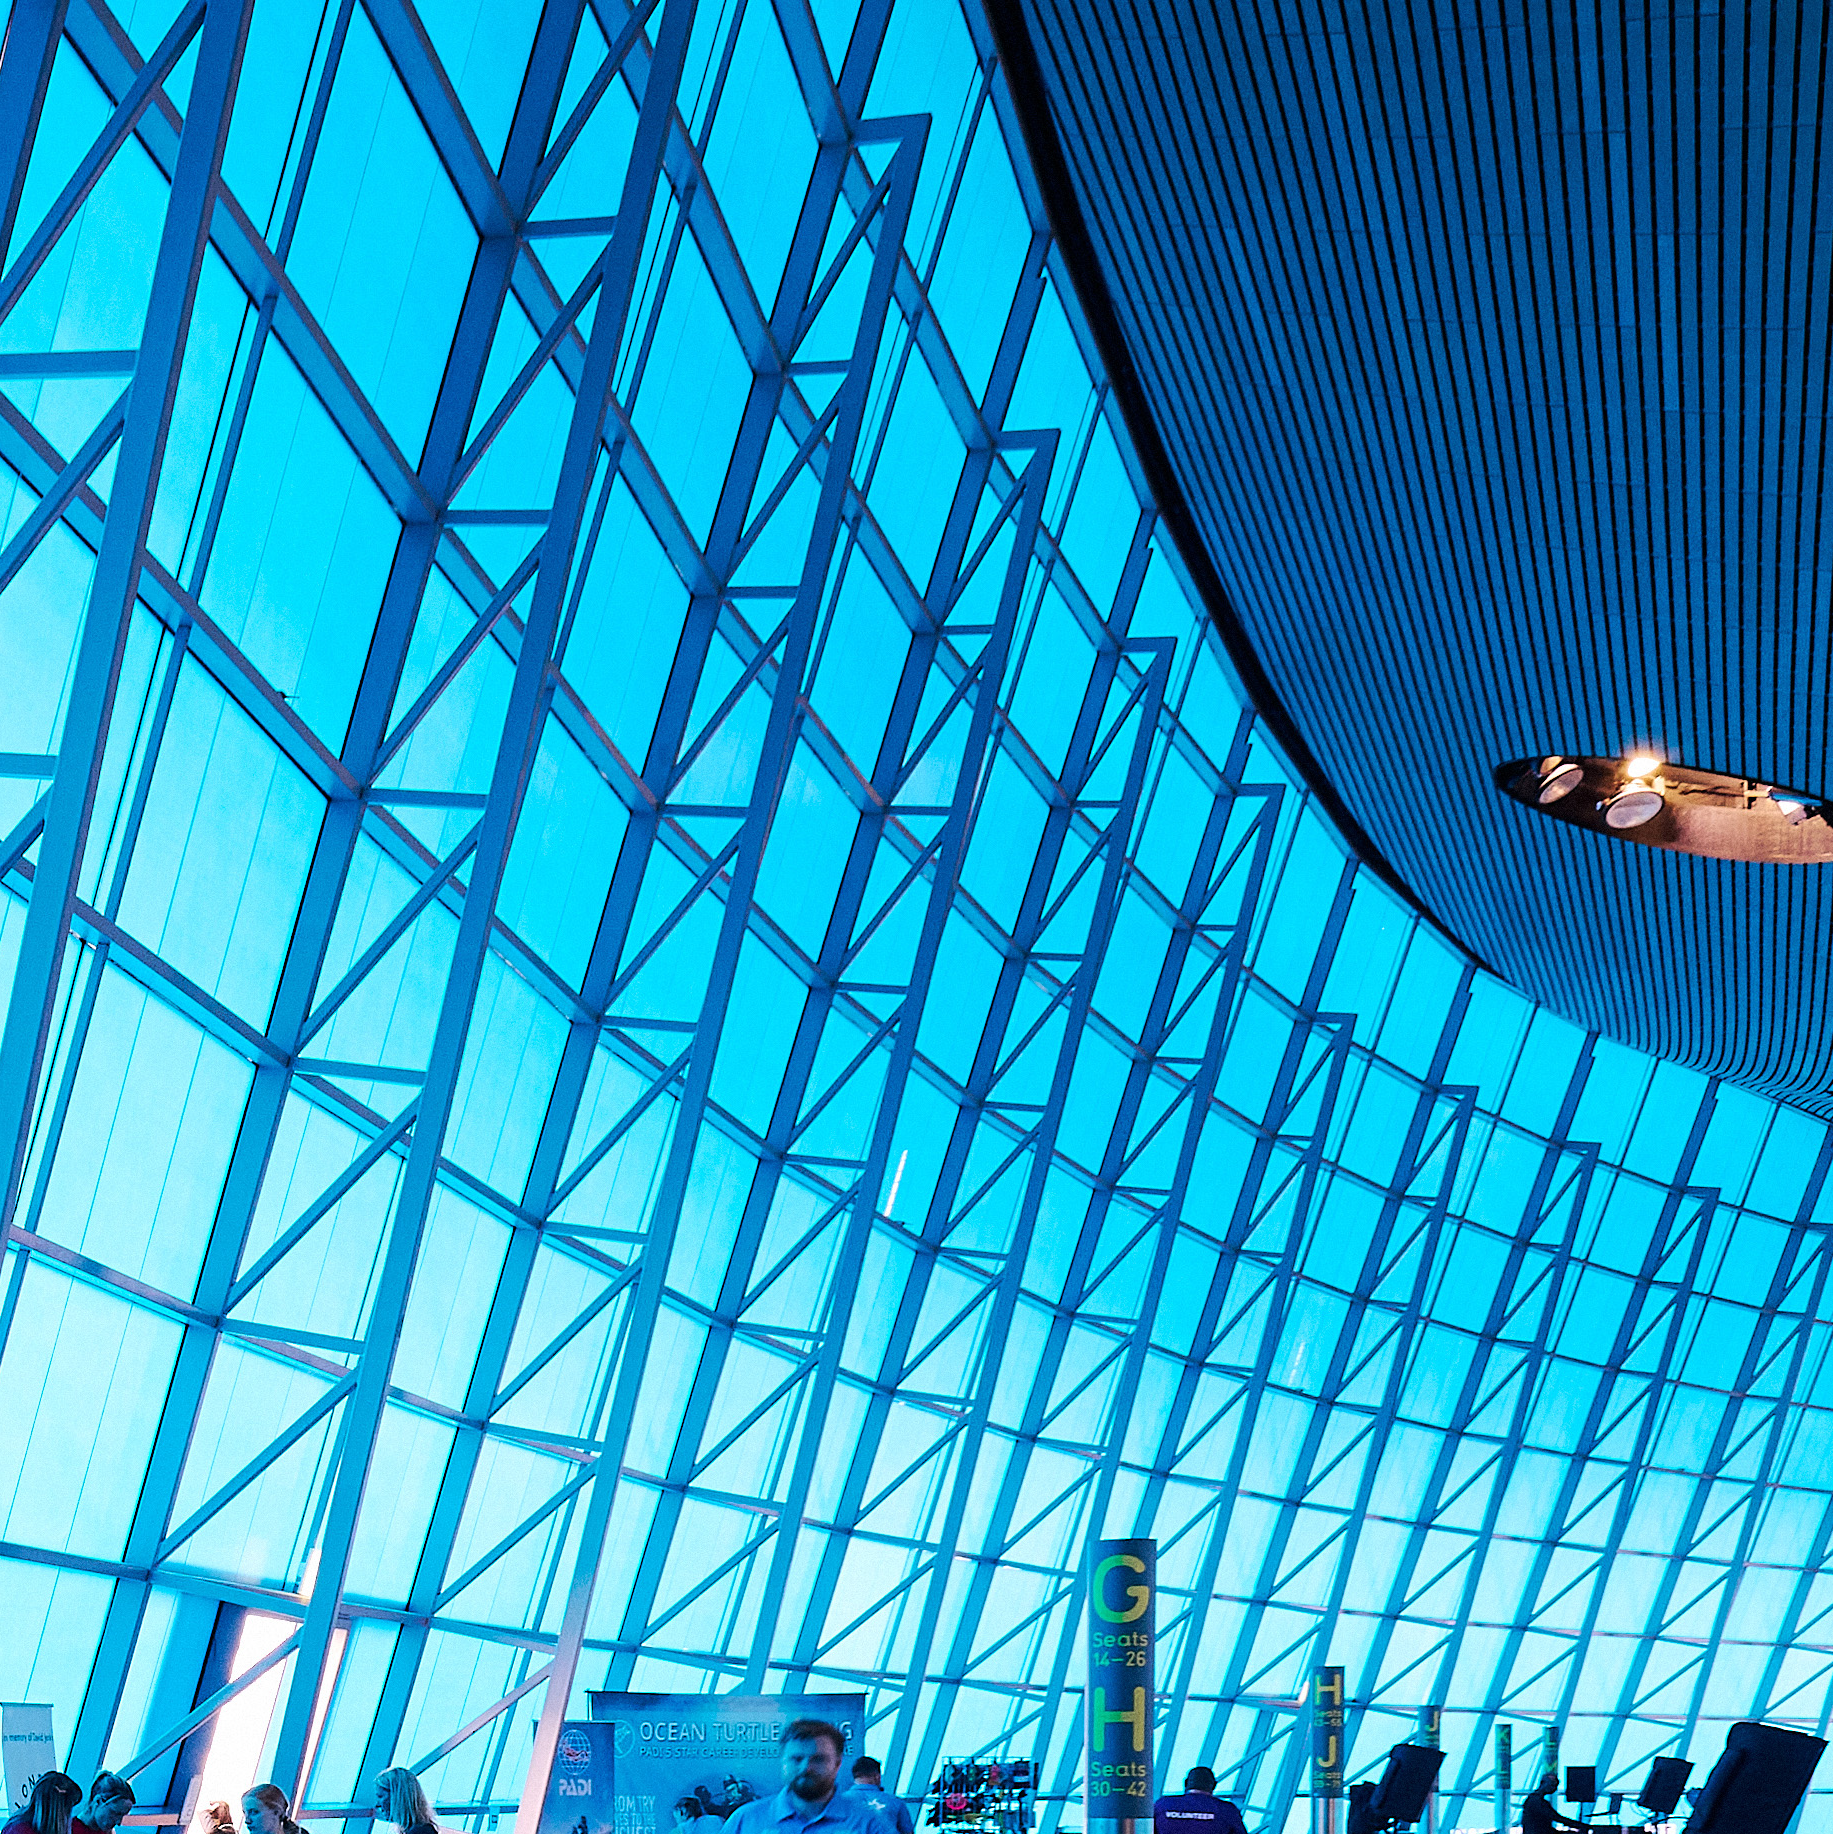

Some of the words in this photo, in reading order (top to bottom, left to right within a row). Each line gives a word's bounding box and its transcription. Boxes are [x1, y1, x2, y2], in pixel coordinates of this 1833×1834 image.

[1092, 1554, 1151, 1624] G
[1092, 1631, 1149, 1648] Seats
[1314, 1674, 1341, 1706] H
[1093, 1686, 1146, 1752] H
[1424, 1711, 1439, 1733] J
[639, 1721, 706, 1742] OCEAN
[712, 1721, 780, 1742] TURTLE
[740, 1747, 780, 1759] DEVELO
[1316, 1735, 1337, 1768] J
[1090, 1760, 1148, 1778] Seats
[558, 1779, 592, 1797] PADI
